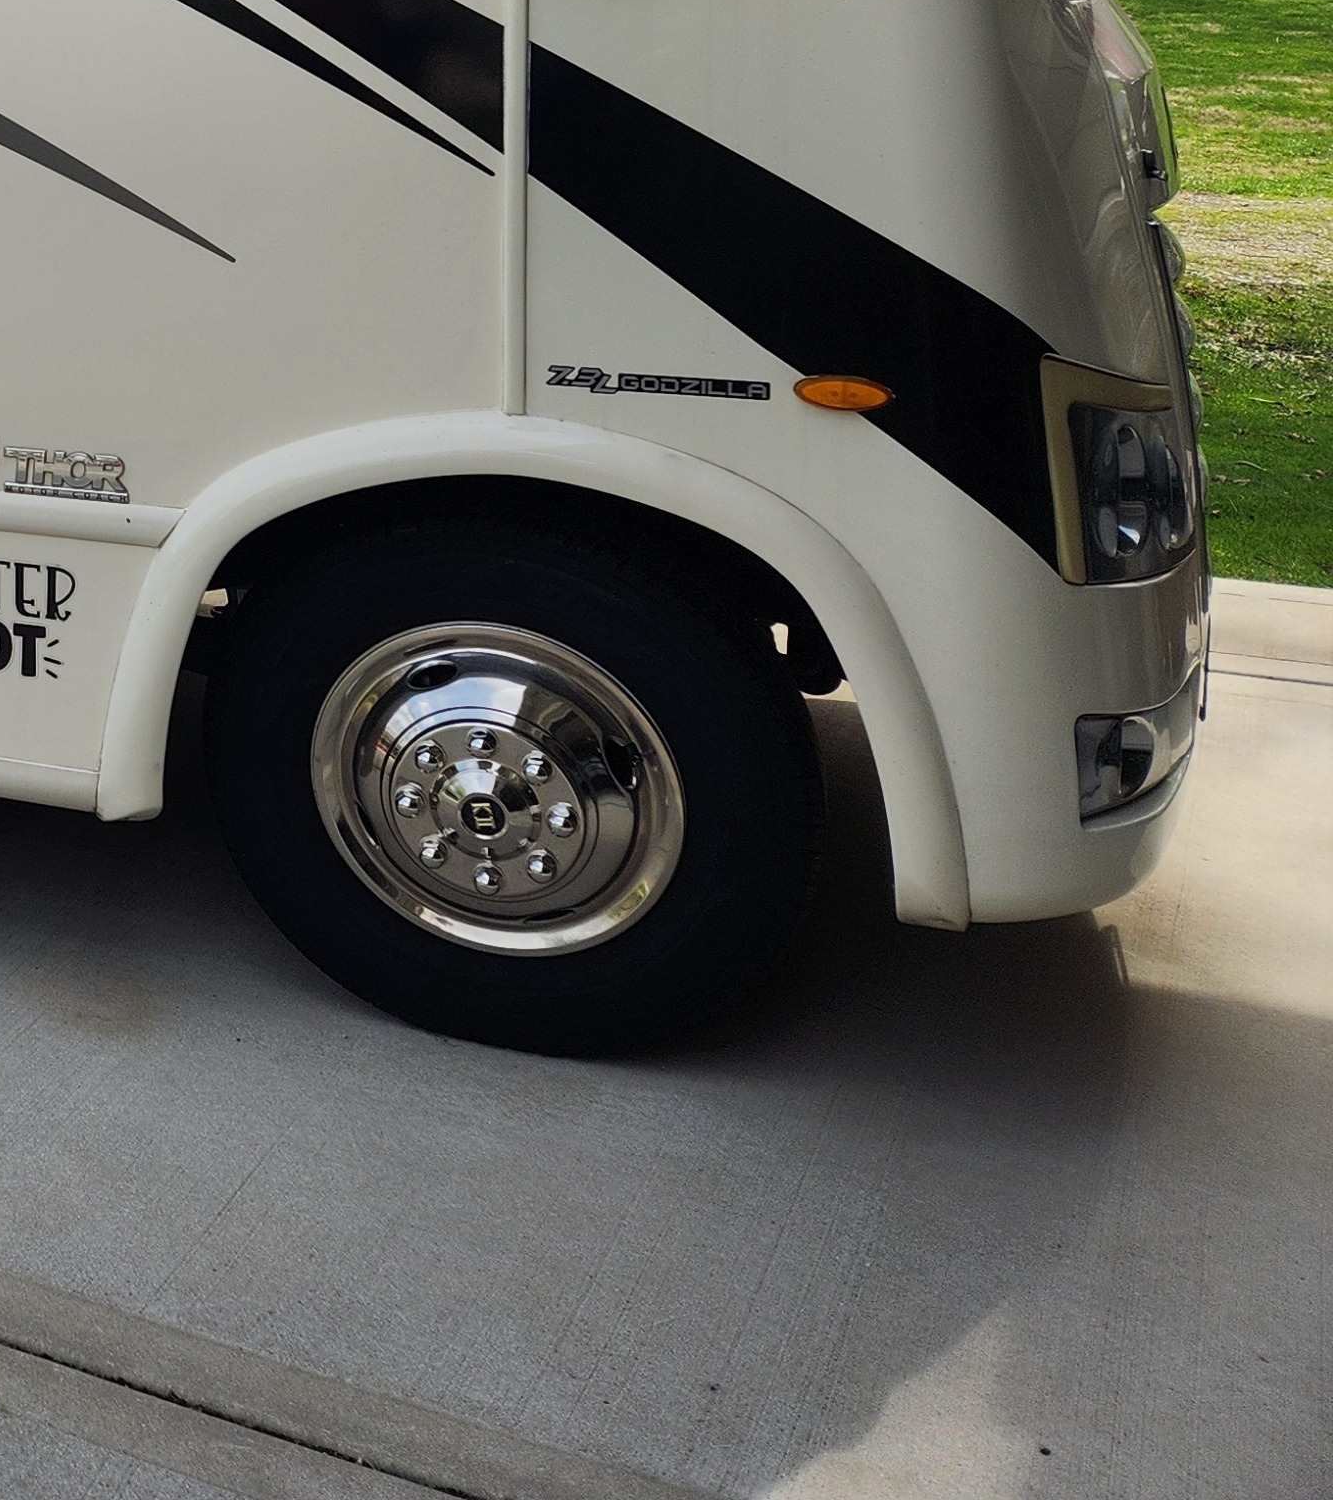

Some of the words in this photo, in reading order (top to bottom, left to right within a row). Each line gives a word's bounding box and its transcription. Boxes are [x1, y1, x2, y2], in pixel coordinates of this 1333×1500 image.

[546, 365, 617, 394] 7.3L
[619, 376, 769, 399] GODZILLA
[4, 446, 127, 491] THOR
[4, 485, 60, 498] MOTOR
[71, 491, 129, 503] COACH
